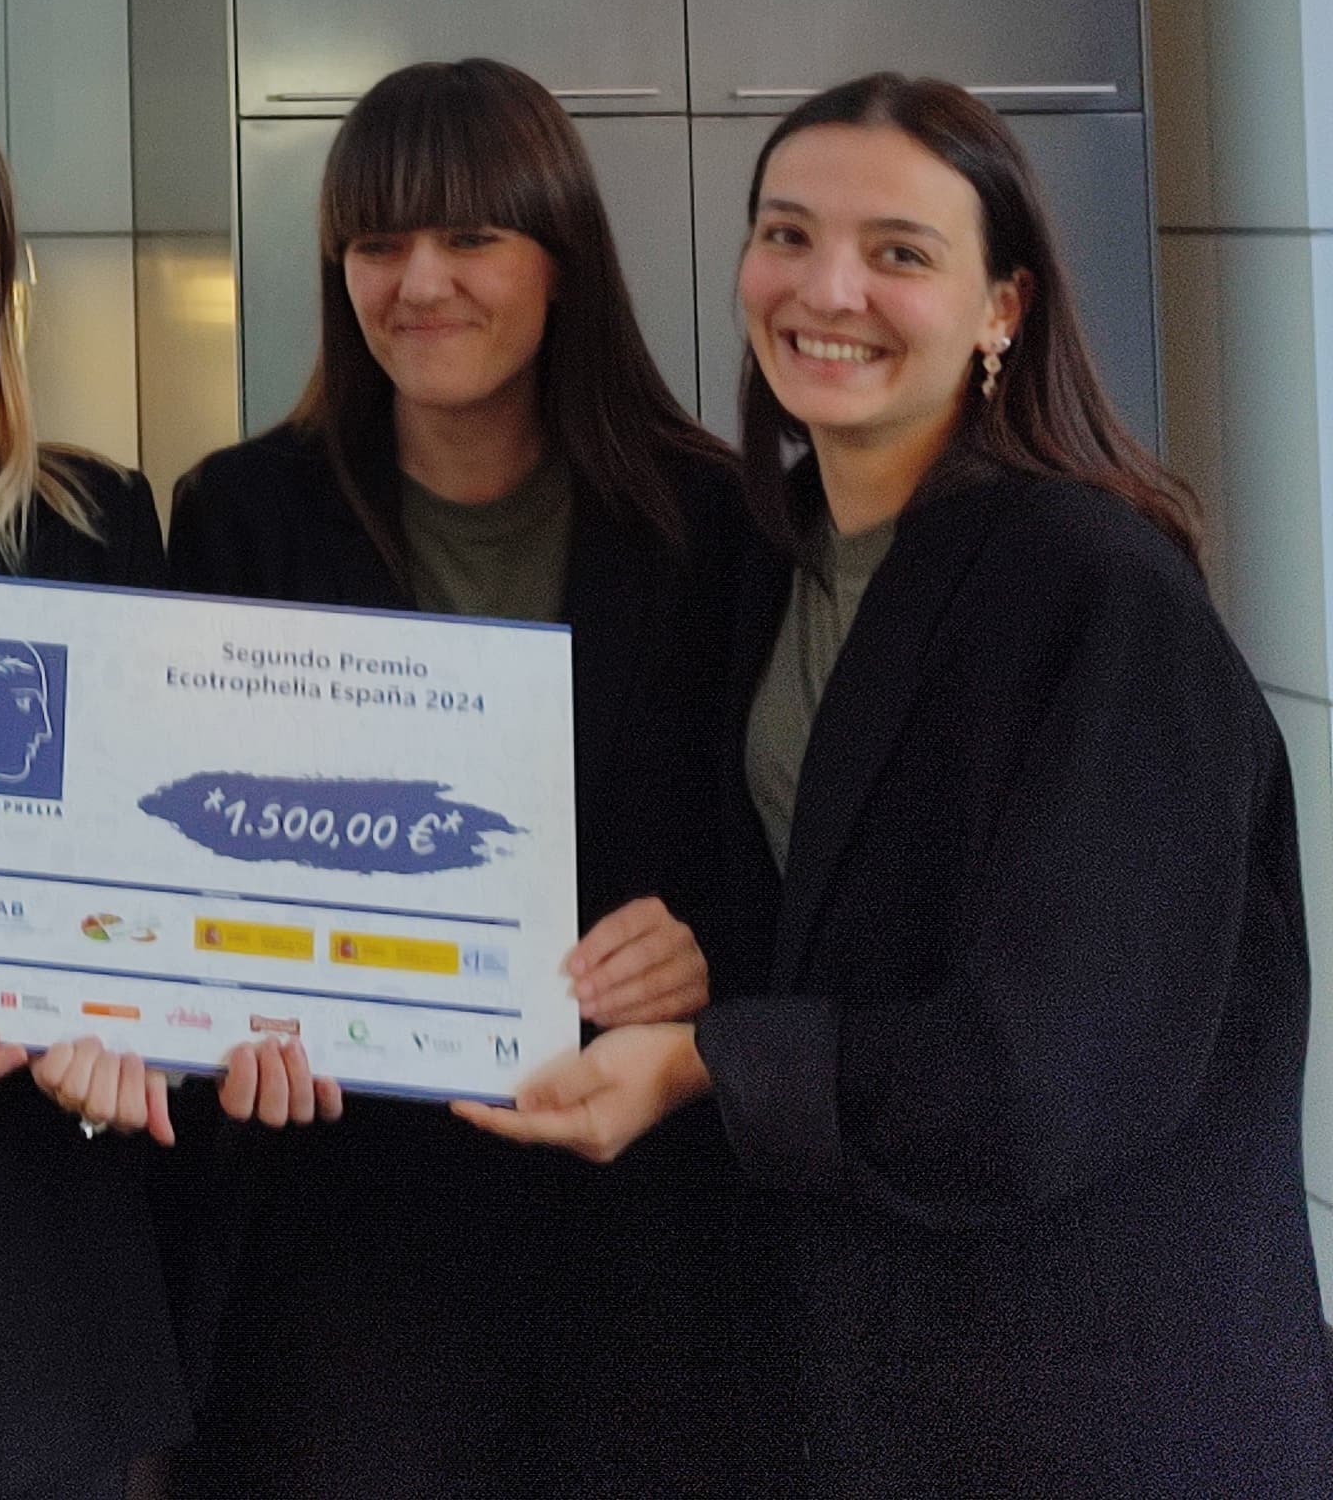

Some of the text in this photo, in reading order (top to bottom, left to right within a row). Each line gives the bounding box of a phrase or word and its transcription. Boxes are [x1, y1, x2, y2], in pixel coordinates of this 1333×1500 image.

[222, 642, 429, 678] Segundo Premio
[166, 666, 485, 714] Ecotrophelia España 2024
